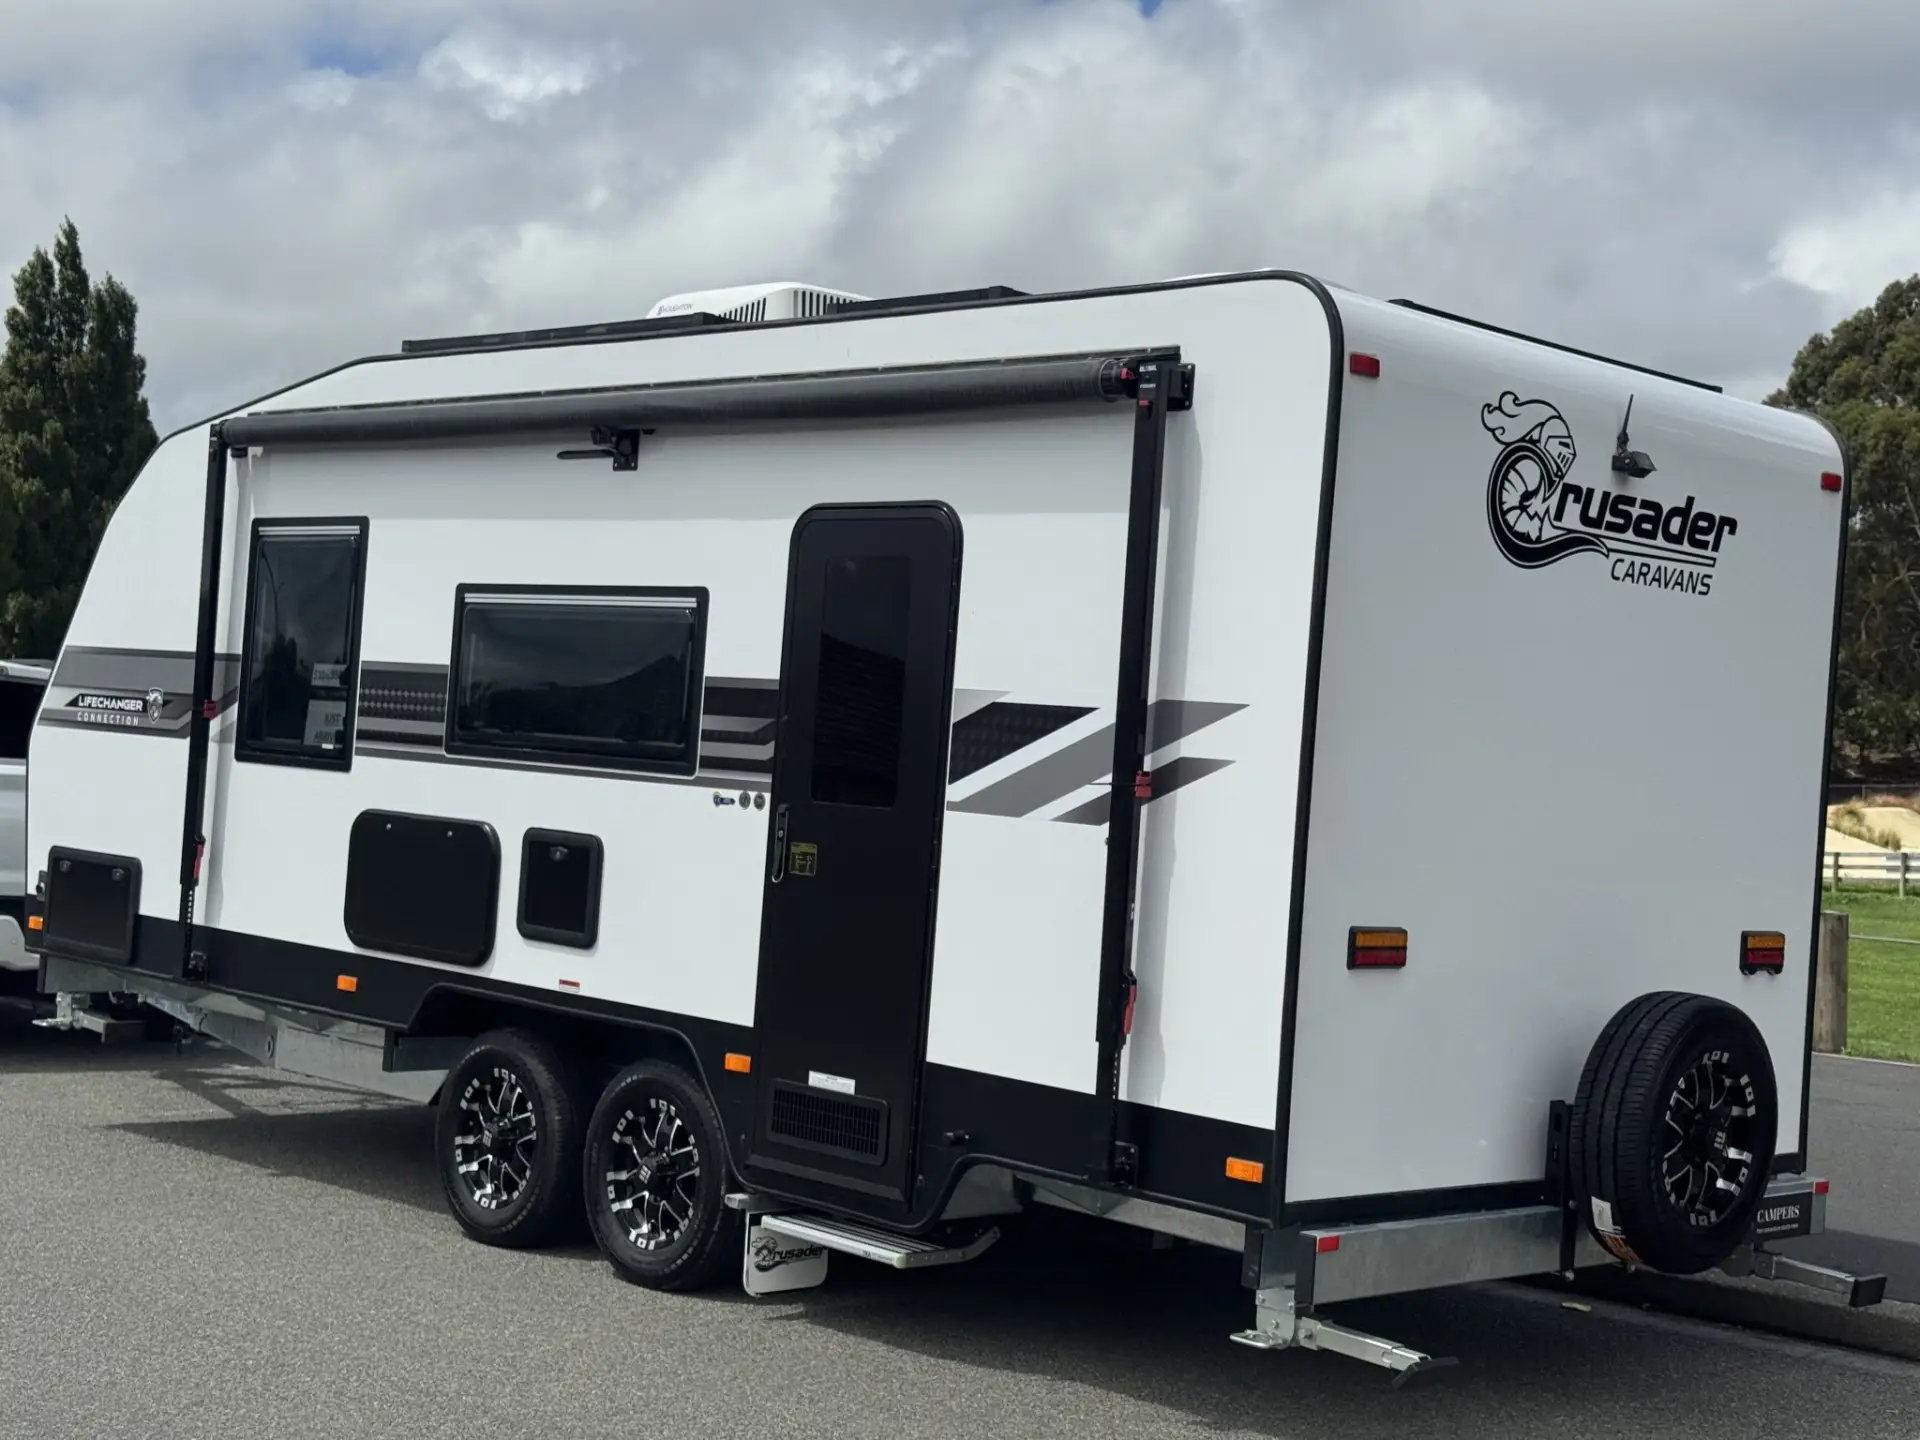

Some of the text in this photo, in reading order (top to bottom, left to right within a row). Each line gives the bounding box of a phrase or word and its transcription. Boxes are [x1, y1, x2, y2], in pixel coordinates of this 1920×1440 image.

[1610, 557, 1713, 596] CARAVANS
[78, 694, 144, 711] LIFECHANGER
[77, 711, 139, 726] CONNECTION
[1757, 1204, 1800, 1223] CAMPERS
